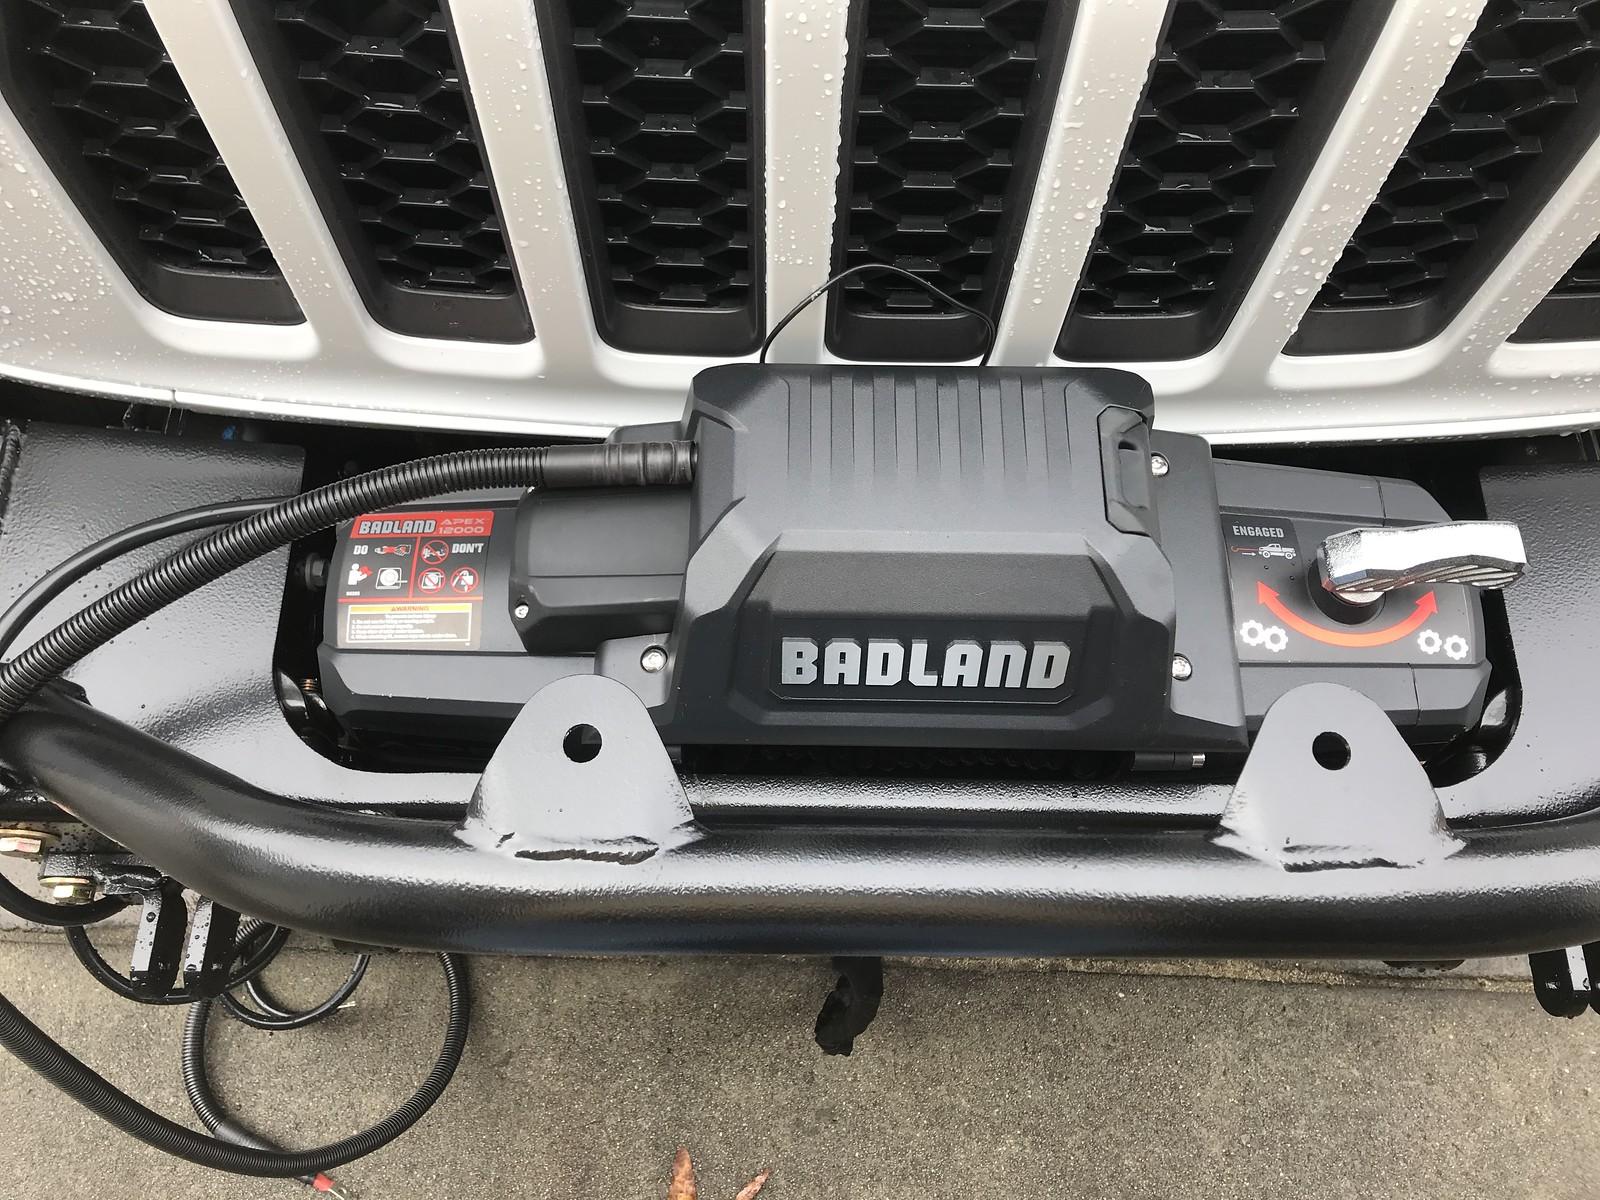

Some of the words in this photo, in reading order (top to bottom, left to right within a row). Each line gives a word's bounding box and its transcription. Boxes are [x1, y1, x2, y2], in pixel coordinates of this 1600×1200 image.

[358, 519, 437, 535] BADLAND
[438, 526, 484, 534] 12000
[1232, 525, 1284, 538] ENGAGED
[353, 545, 369, 555] DO
[451, 543, 484, 554] DON'T
[781, 637, 1071, 689] BADLAND
